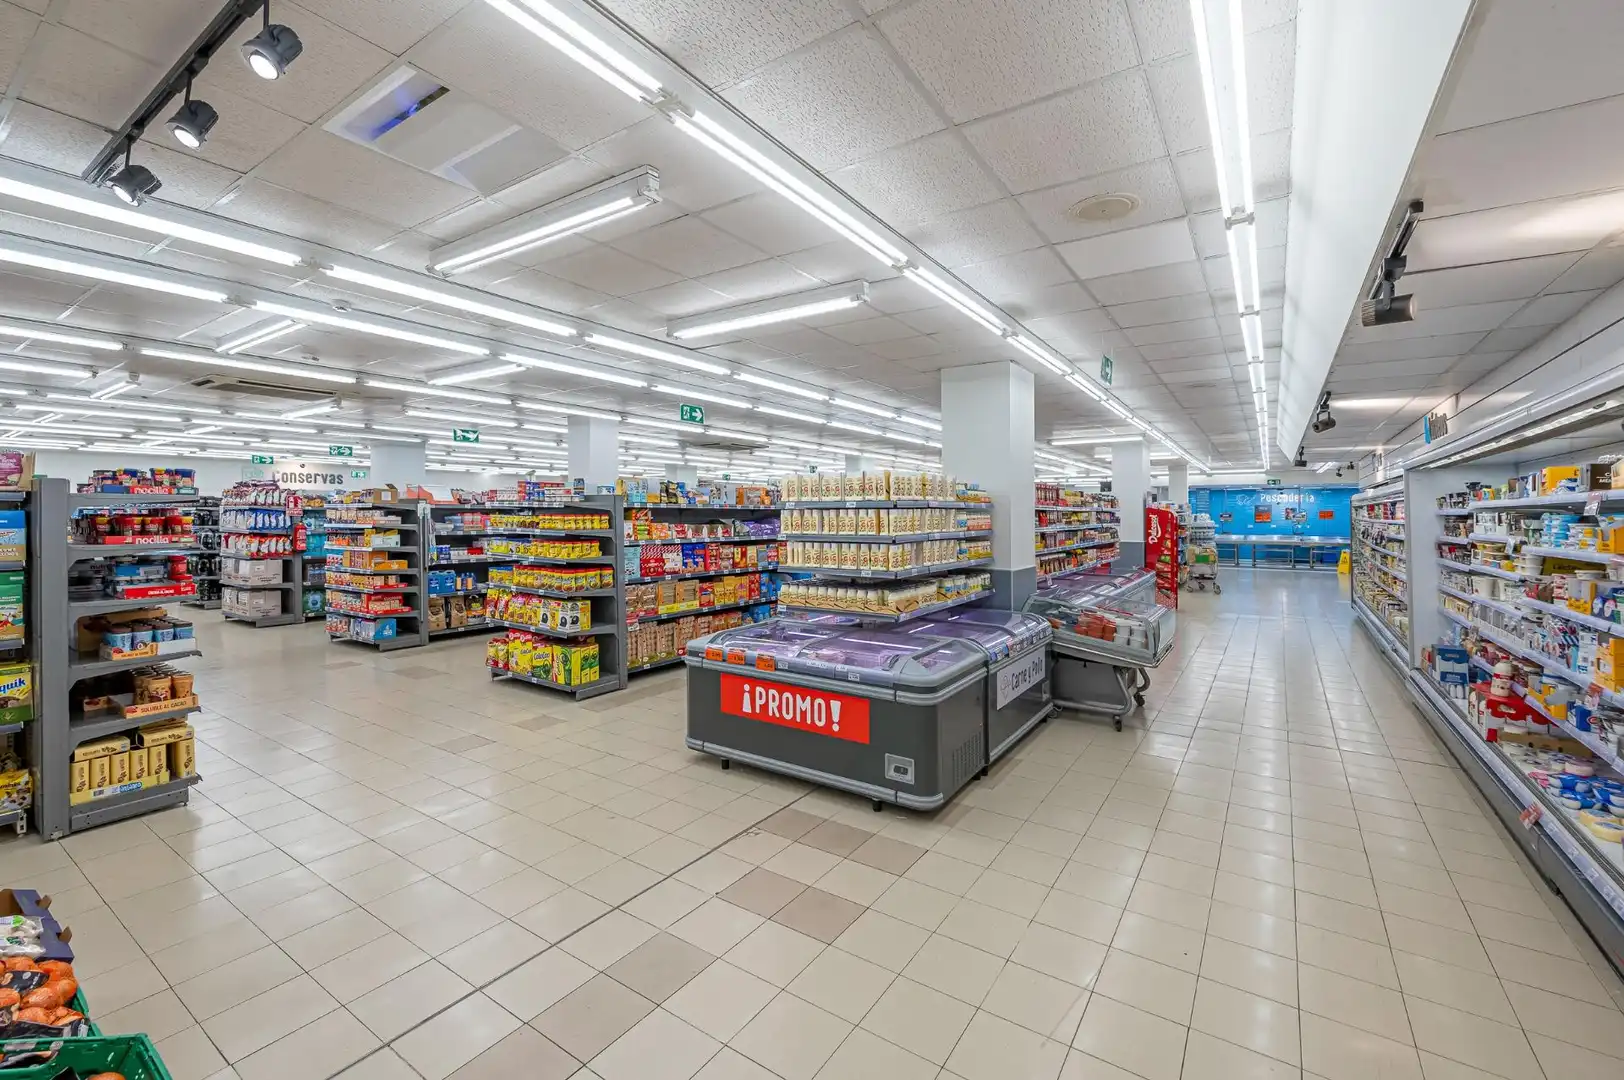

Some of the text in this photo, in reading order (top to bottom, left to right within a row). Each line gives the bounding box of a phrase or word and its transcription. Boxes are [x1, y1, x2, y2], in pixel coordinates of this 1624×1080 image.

[272, 472, 343, 485] Conservas
[135, 536, 169, 544] nocilla
[1012, 669, 1027, 691] Carne
[743, 683, 842, 732] ¡PROMO!
